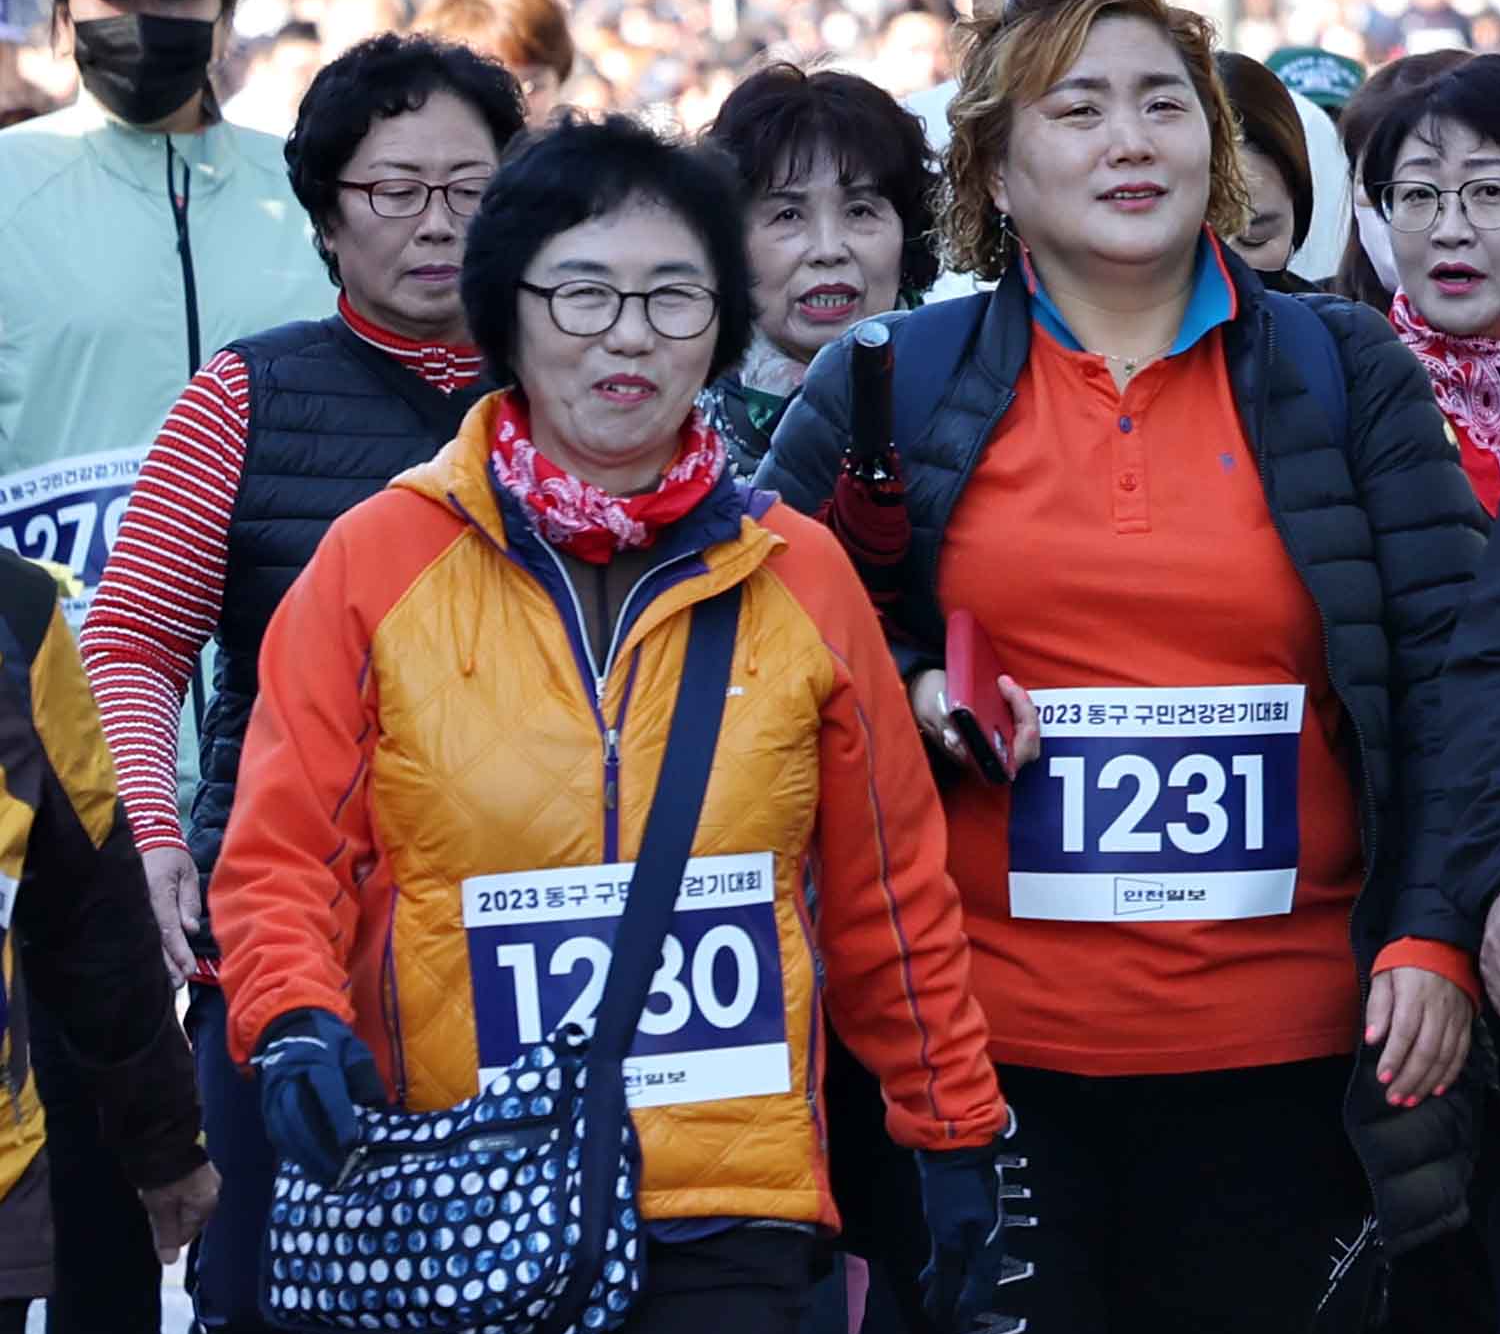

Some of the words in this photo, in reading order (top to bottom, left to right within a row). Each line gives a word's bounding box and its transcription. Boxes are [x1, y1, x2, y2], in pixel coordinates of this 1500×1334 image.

[1088, 705, 1129, 725] 동구
[1134, 702, 1290, 725] 구민건강걷기대회
[1049, 754, 1263, 854] 1231
[478, 887, 539, 913] 2023
[545, 884, 590, 908] 동구
